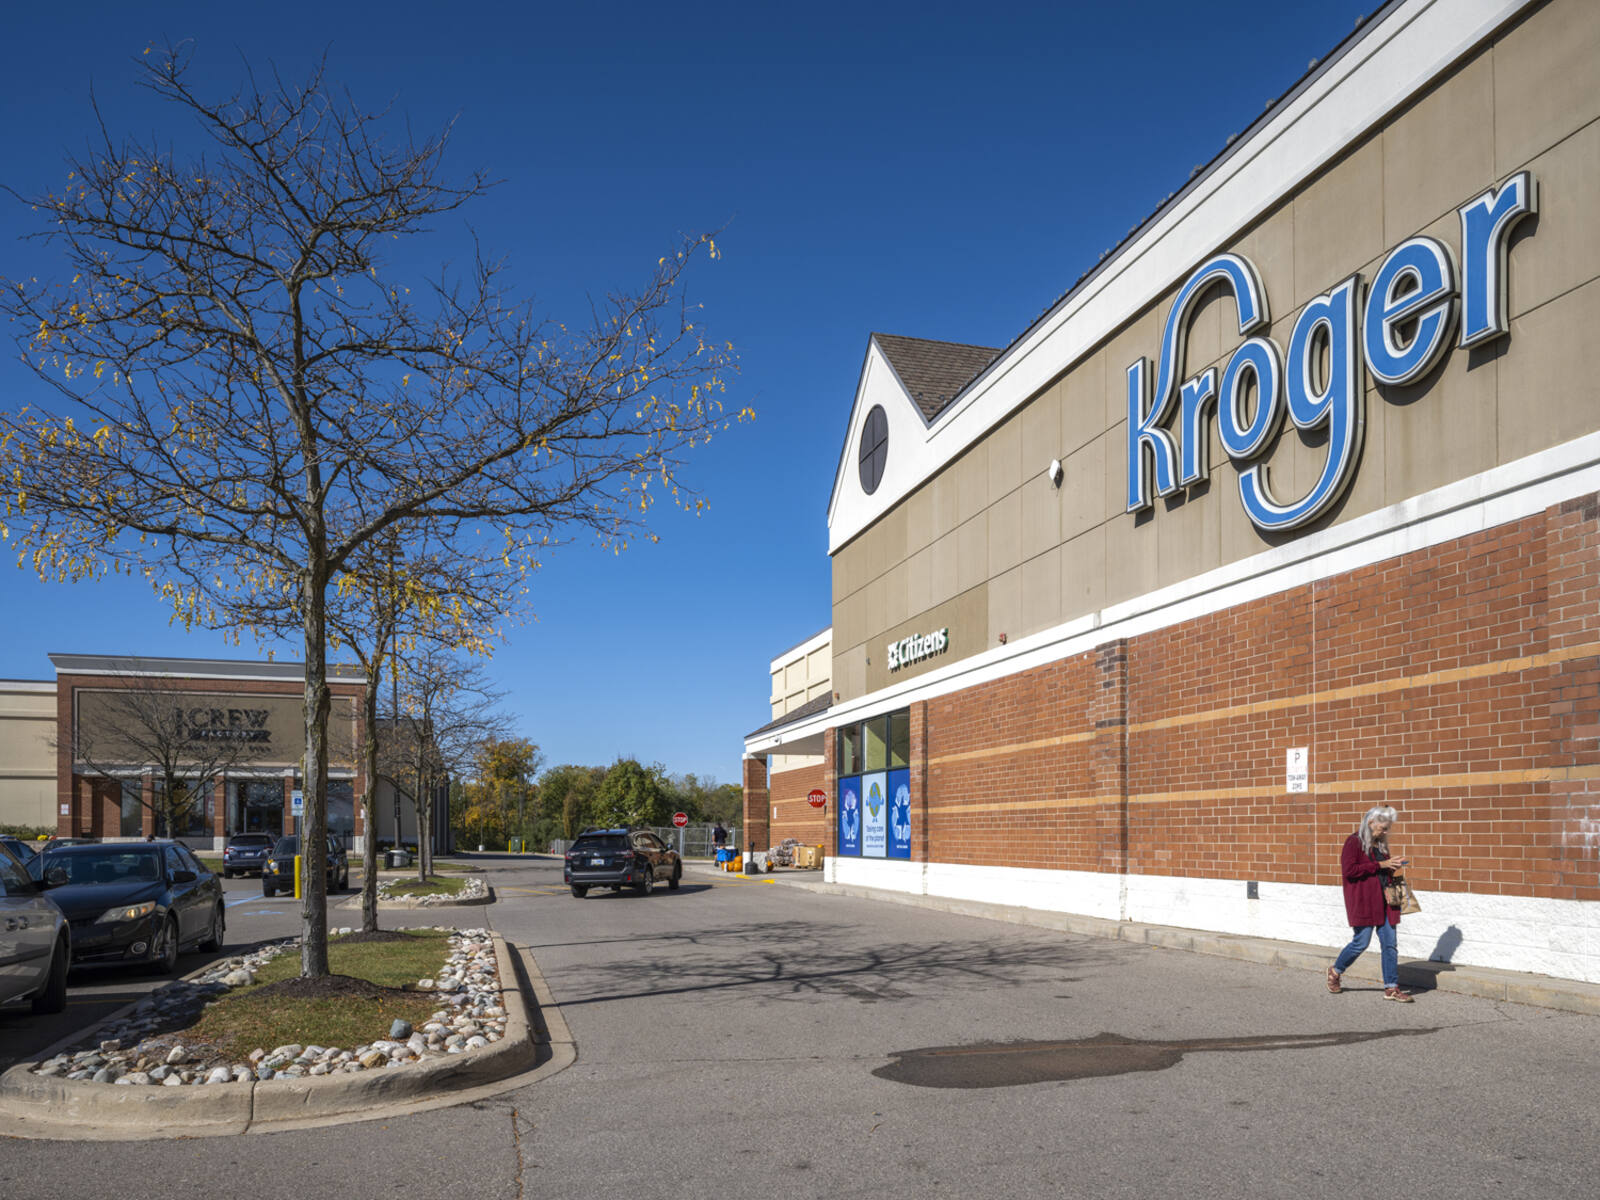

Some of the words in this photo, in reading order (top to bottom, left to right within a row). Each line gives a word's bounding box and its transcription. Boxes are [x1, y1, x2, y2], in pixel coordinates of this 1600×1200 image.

[1126, 170, 1538, 532] Kroger
[898, 627, 948, 664] Citizens
[808, 794, 825, 803] STOP
